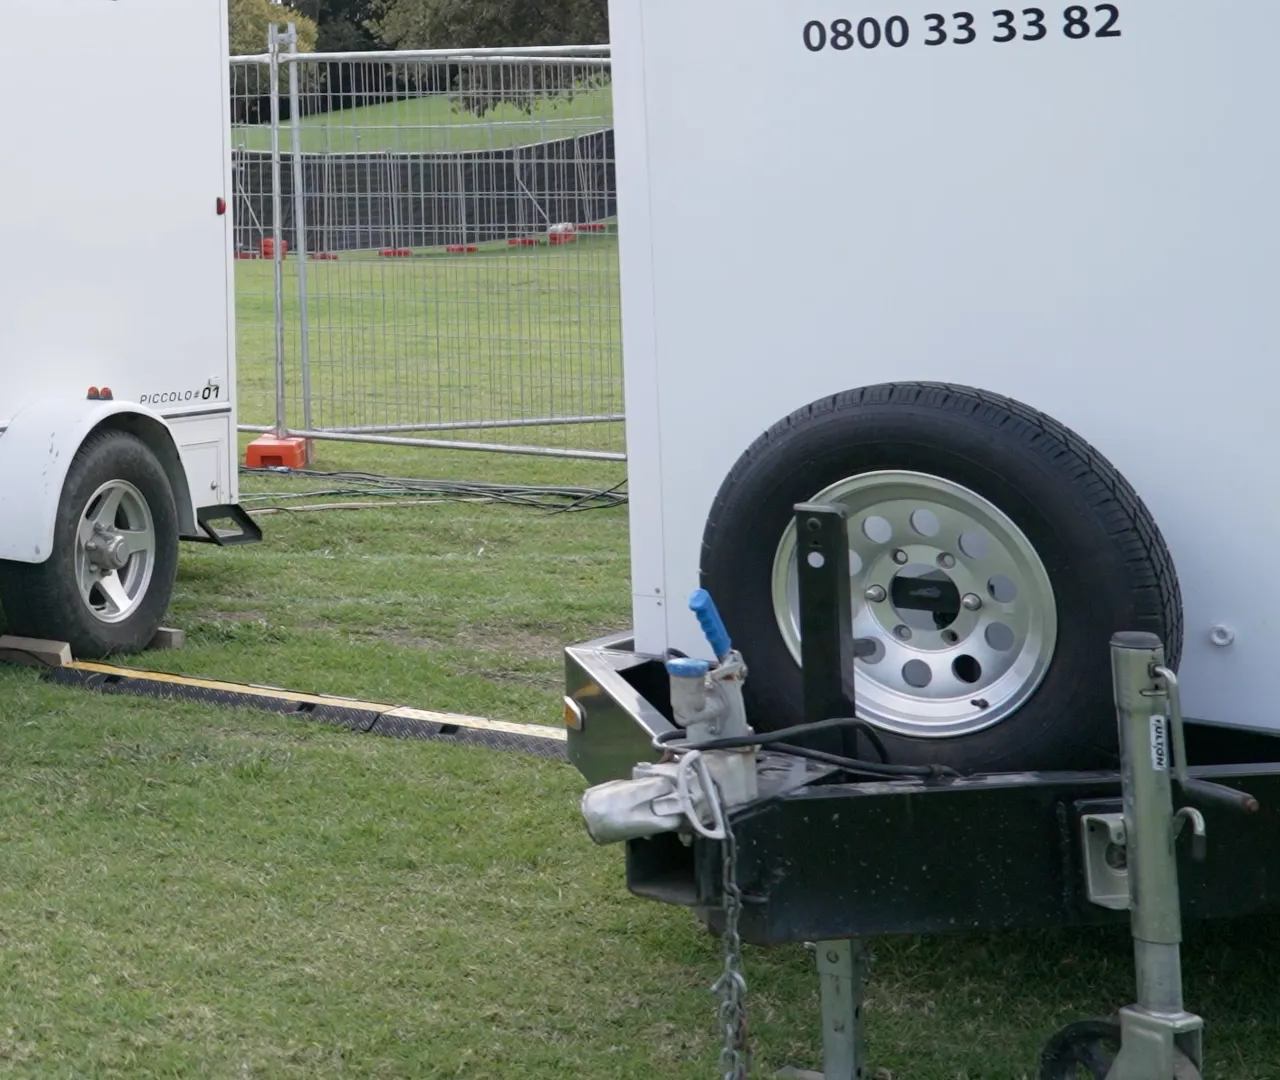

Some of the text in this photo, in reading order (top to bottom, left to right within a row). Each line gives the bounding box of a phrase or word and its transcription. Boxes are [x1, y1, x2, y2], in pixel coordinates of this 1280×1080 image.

[803, 3, 1122, 52] 0800 33 33 82
